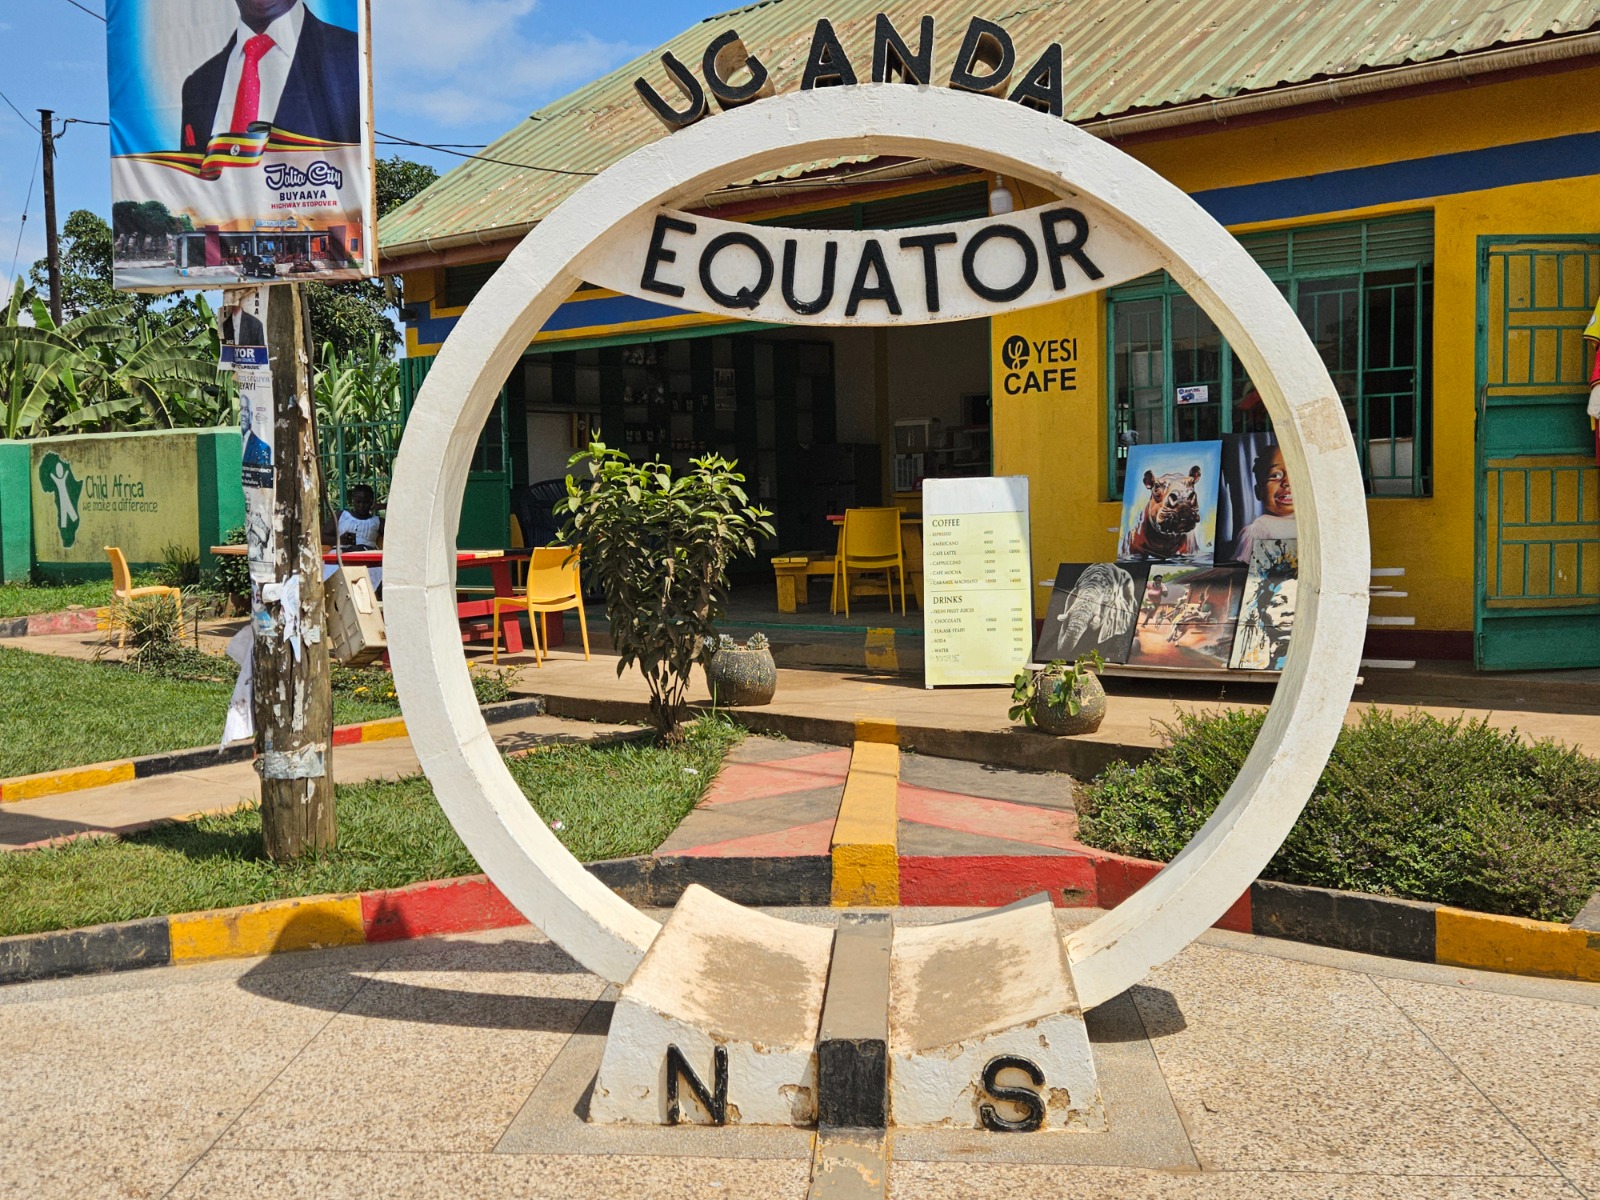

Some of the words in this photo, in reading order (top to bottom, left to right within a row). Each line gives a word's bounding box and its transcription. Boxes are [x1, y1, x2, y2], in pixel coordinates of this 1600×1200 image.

[634, 13, 1064, 128] UGANDA
[306, 161, 343, 190] City
[279, 190, 327, 201] BUYAAYA
[302, 200, 337, 208] STOPOVER
[640, 207, 1105, 317] EQUATOR
[1032, 338, 1078, 364] YESI
[1004, 368, 1077, 395] CAFE
[85, 475, 108, 499] Child
[111, 475, 144, 498] Africa
[82, 502, 92, 511] we
[93, 499, 111, 511] make
[112, 503, 117, 511] a
[118, 498, 158, 513] difference
[932, 519, 960, 527] COFFEE
[933, 596, 963, 604] DRINKS
[667, 1044, 728, 1126] N
[979, 1054, 1046, 1132] S
